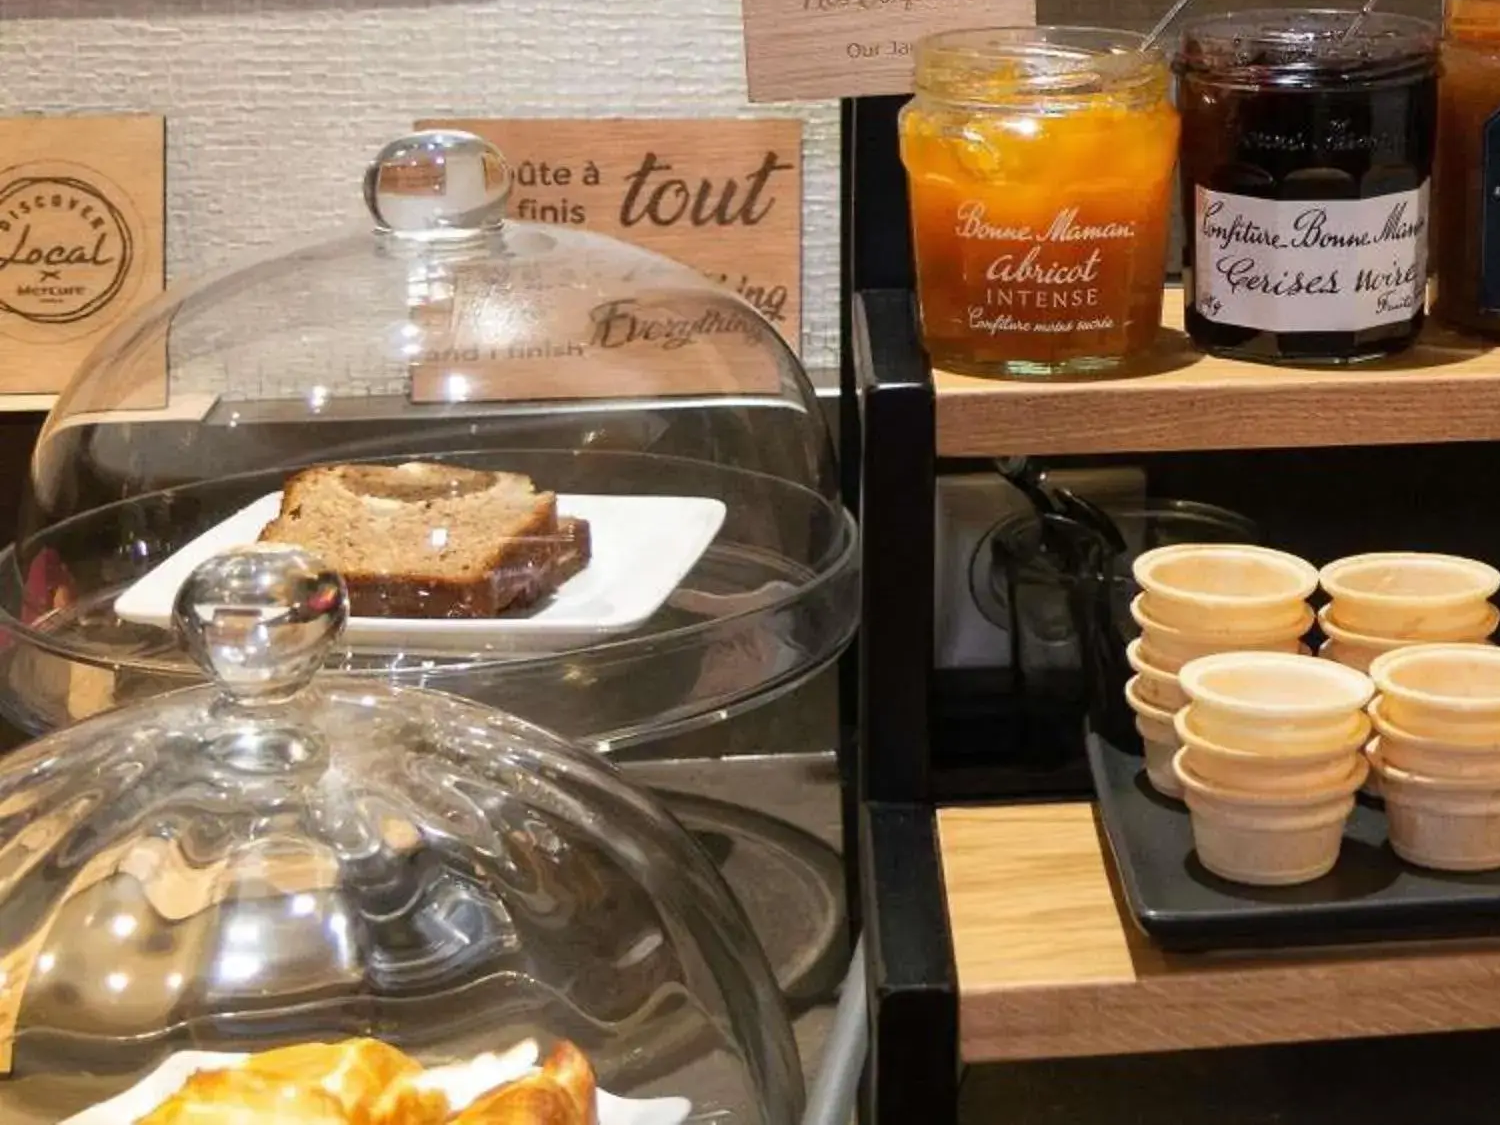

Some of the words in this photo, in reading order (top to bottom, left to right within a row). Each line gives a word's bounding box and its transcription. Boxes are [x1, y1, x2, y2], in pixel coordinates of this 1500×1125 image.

[847, 42, 879, 59] Our
[885, 40, 914, 55] Ja
[510, 160, 573, 185] ûte
[582, 160, 601, 185] à
[620, 150, 793, 228] tout
[0, 194, 106, 232] DISCOVER
[518, 198, 586, 224] finis
[955, 200, 1033, 241] Bonne
[1036, 207, 1135, 242] Maman
[1291, 208, 1371, 248] Bonne
[0, 223, 115, 270] Local
[1216, 255, 1341, 296] Cerises
[986, 288, 1099, 308] INTENSE
